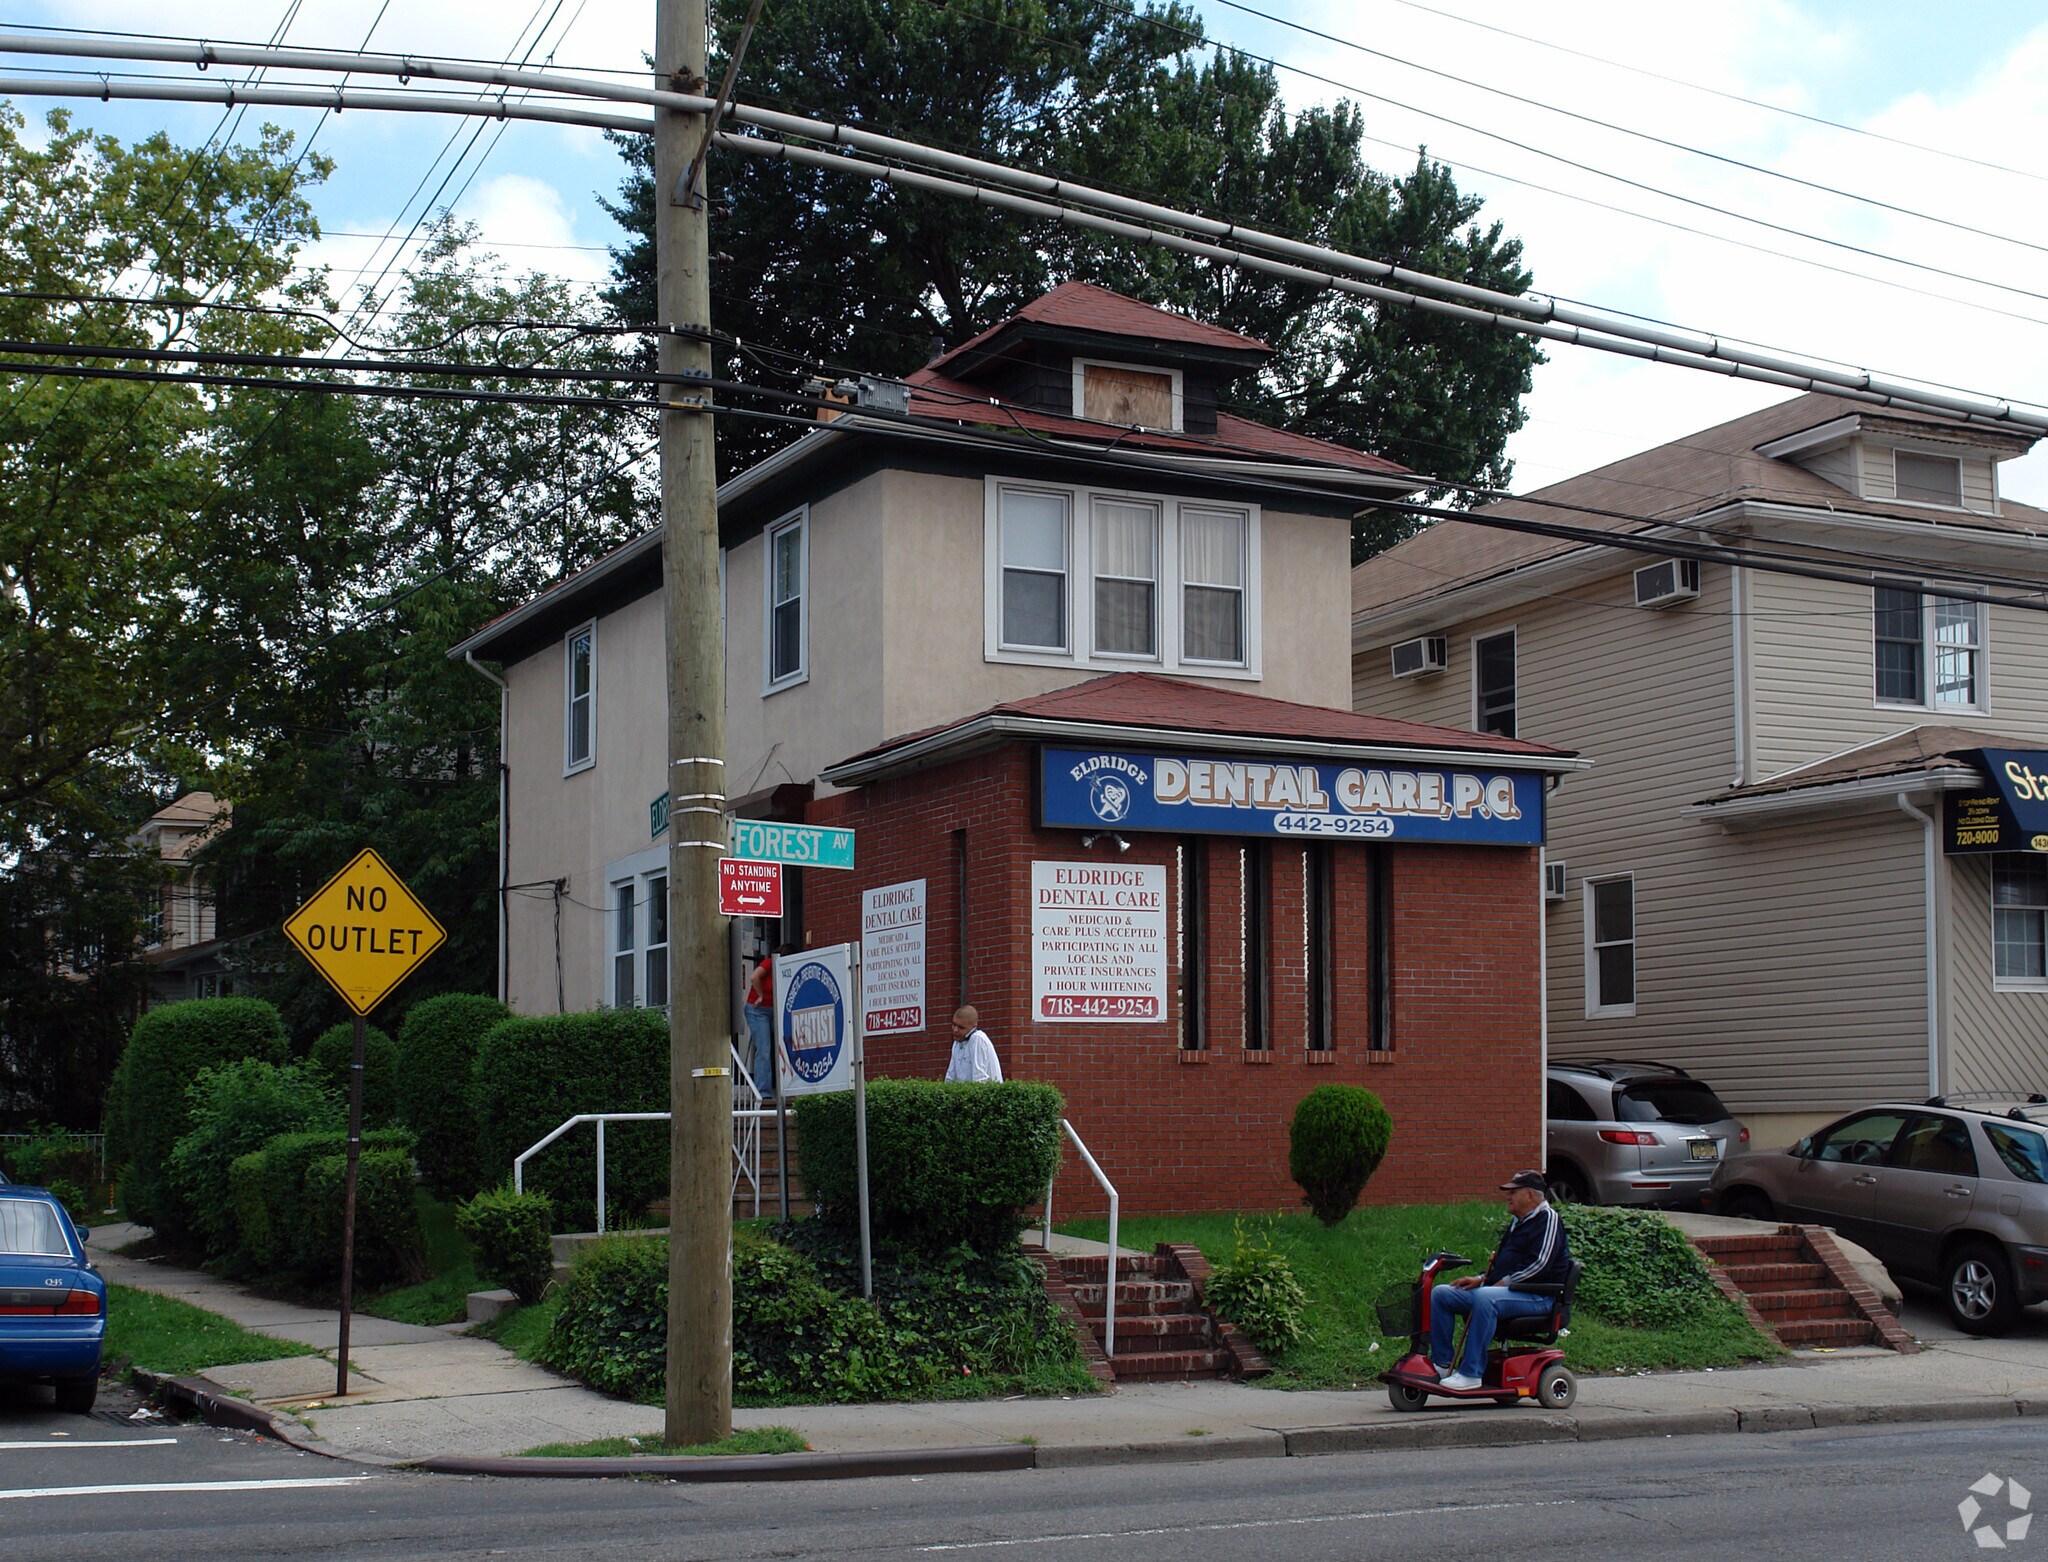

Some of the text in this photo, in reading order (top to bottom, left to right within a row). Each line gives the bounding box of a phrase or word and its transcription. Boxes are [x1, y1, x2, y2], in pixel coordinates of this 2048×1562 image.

[1070, 755, 1148, 785] ELDRIDGE
[1154, 758, 1329, 813] DENTAL
[1453, 774, 1522, 820] P.C.
[1278, 815, 1390, 834] 442-9254
[735, 825, 849, 861] FOREST AV
[1957, 830, 1999, 845] 720-9000
[723, 863, 777, 878] NO STANDING
[1056, 868, 1144, 886] ELDRIDGE
[730, 879, 771, 893] ANYTIME
[346, 885, 387, 913] NO
[872, 887, 915, 910] ELDRIDGE
[1039, 888, 1160, 907] DENTAL CARE
[865, 905, 923, 930] DENTAL CARE
[1068, 915, 1132, 926] MEDICAID &
[307, 924, 423, 956] OUTLET
[878, 932, 904, 945] MEDICAID
[1042, 926, 1157, 938] CARE PLUS ACCEPTED
[866, 941, 921, 958] CARE PLUS ACCEPTED
[1041, 941, 1158, 953] PARTICIPATING IN ALL
[866, 955, 921, 972] PARTICIPATING IN ALL
[1067, 954, 1134, 965] LOCALS AND
[878, 969, 910, 981] LOCALS AND
[1044, 966, 1157, 977] PRIVATE INSURANCES
[867, 979, 921, 994] PRIVATE INSURANCES
[1048, 981, 1152, 992] 1 HOUR WHITENING
[872, 997, 887, 1007] HOUR
[888, 993, 918, 1005] WHITENING
[1047, 998, 1153, 1015] 718-442-9254
[792, 1008, 834, 1046] DENTIST
[868, 1009, 919, 1029] 718-442-9254
[795, 1051, 833, 1078] 442-9254
